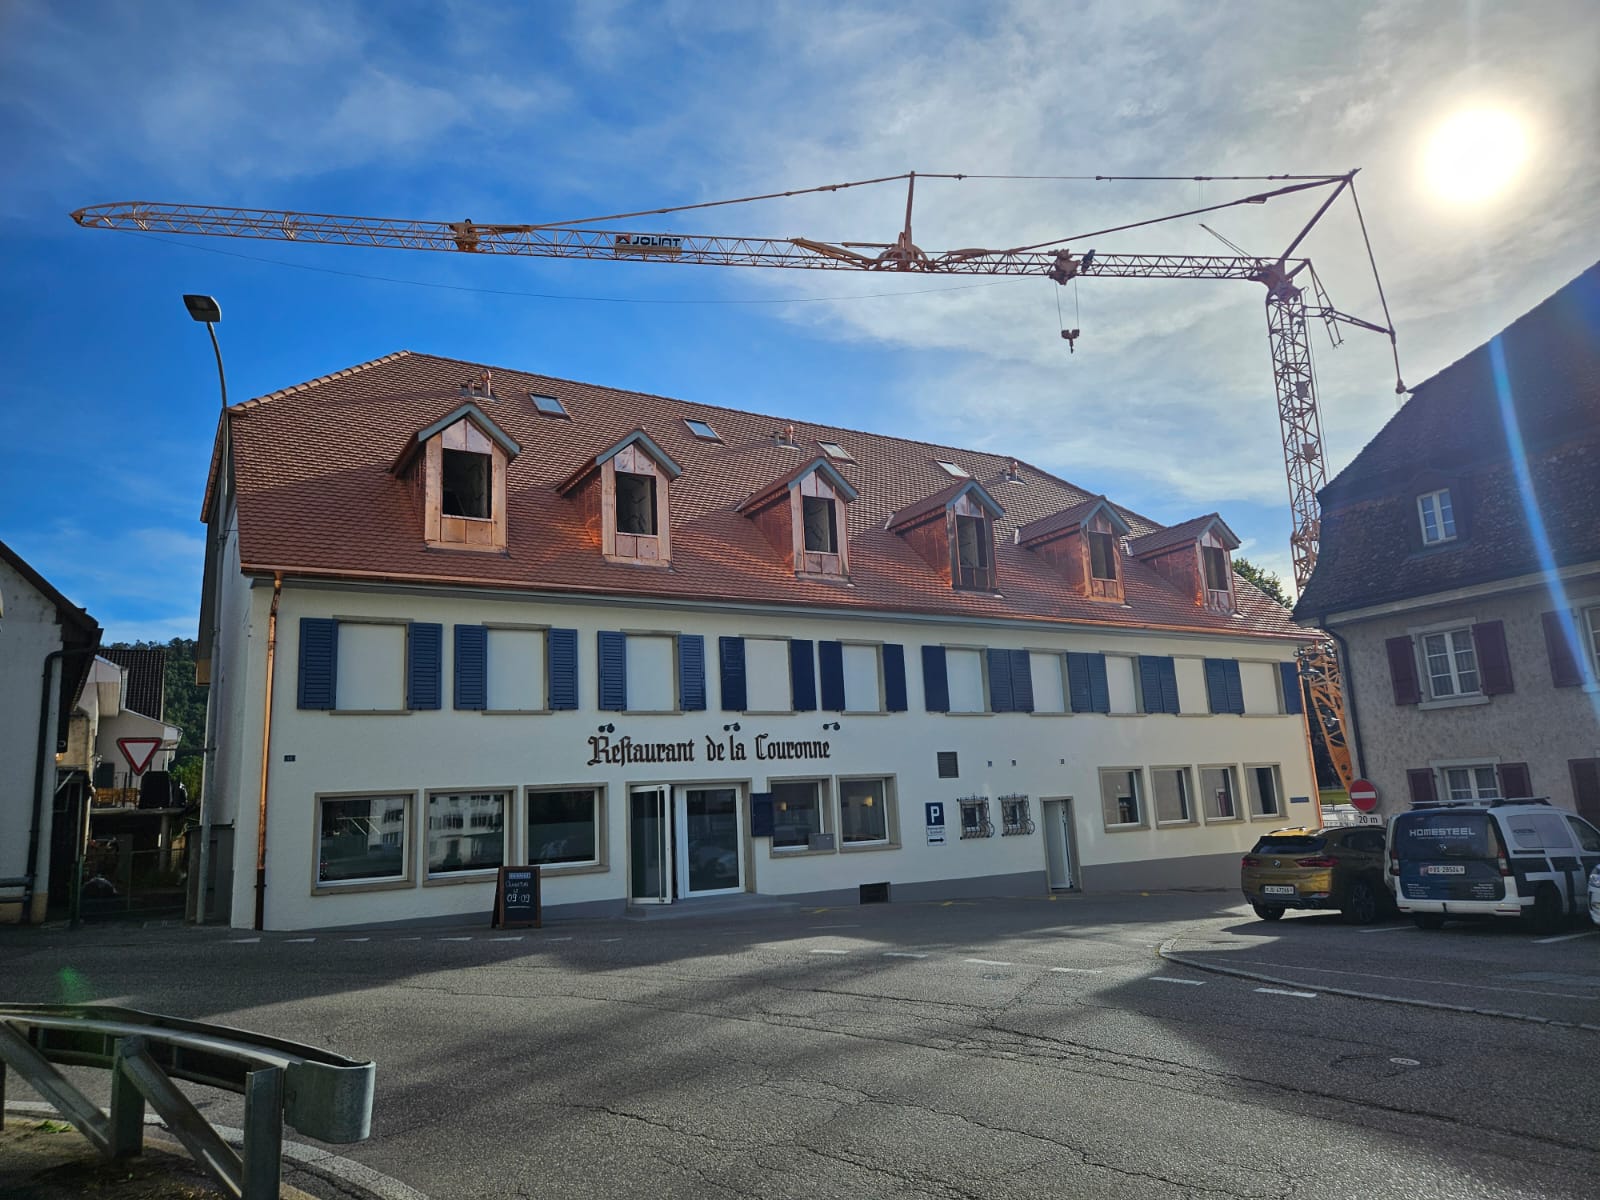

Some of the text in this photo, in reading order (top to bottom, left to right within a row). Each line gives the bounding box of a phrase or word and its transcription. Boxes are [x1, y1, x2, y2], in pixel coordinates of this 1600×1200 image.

[587, 733, 831, 767] Restaurant de la Couronne
[930, 805, 940, 824] P
[1358, 815, 1368, 824] 20
[1409, 827, 1475, 837] HOMESTEEL
